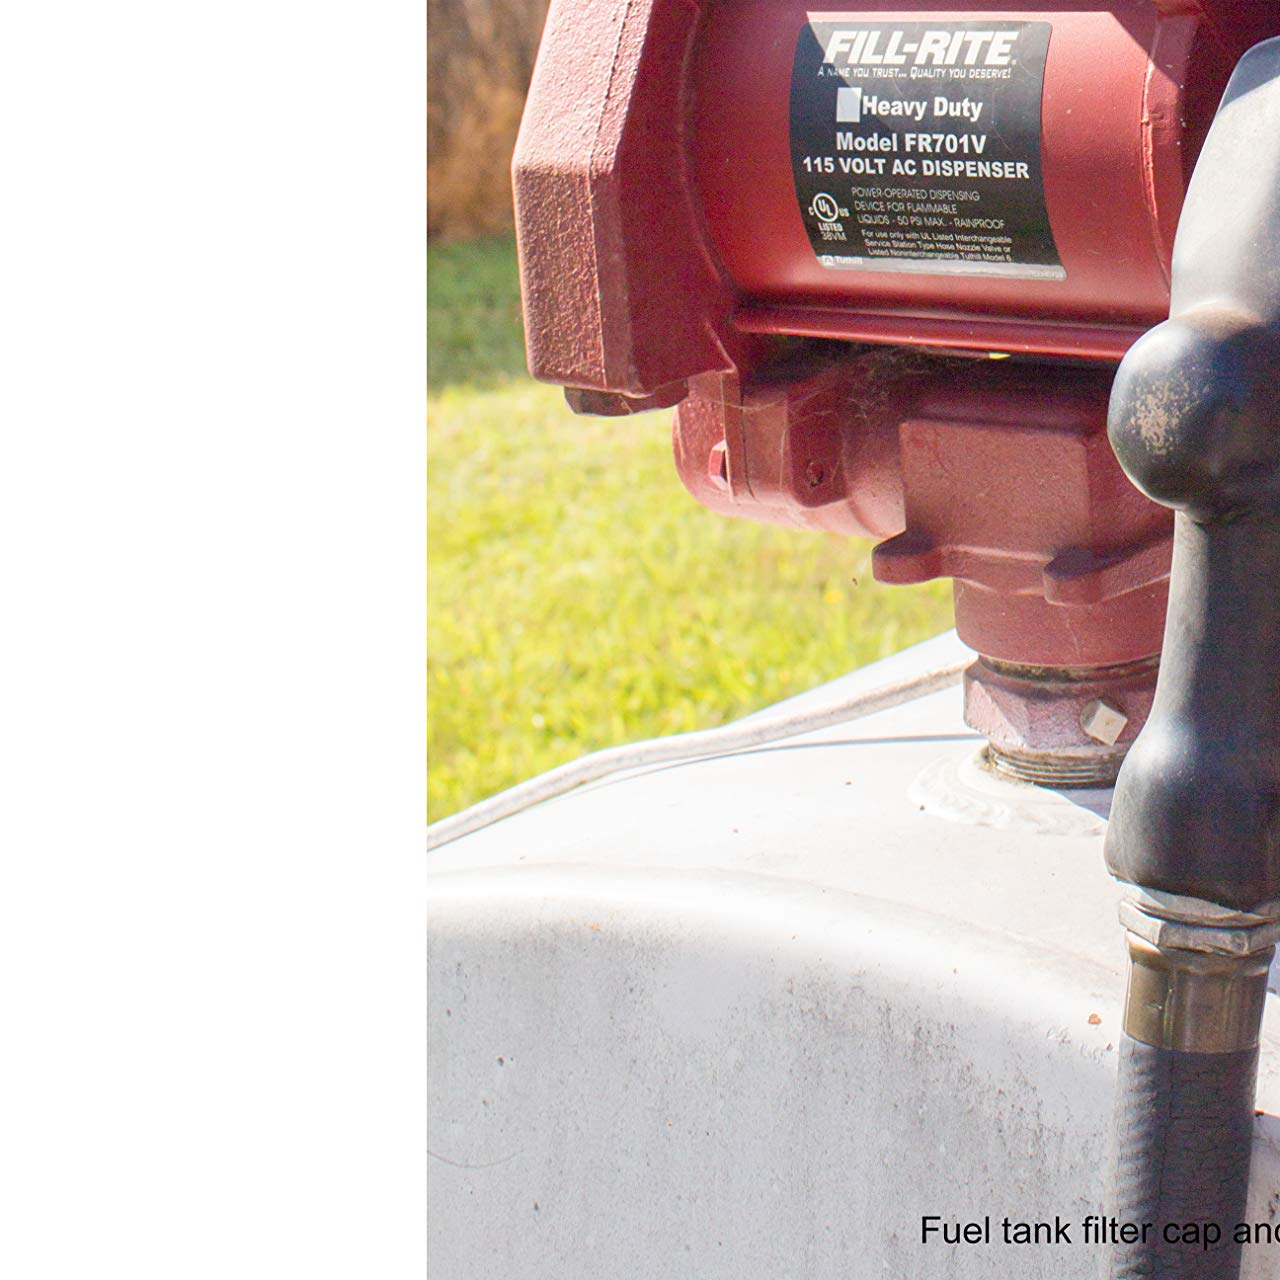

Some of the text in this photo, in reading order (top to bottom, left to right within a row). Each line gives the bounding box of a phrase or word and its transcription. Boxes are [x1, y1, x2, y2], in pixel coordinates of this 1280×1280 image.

[823, 30, 1019, 65] FILL-RITE
[818, 67, 824, 76] A
[852, 67, 870, 78] YOU
[949, 68, 967, 79] YOU
[862, 95, 983, 122] Heavy Duty
[836, 132, 987, 154] Model FR701V
[803, 156, 1029, 179] 115 VOLT AC DISPENSER
[851, 187, 980, 201] POWER-OPERATED DISPENSING
[854, 201, 958, 214] DEVICE FOR FLAMMABLE
[818, 222, 843, 232] LISTED
[857, 214, 890, 225] LIQUIDS
[897, 216, 908, 225] 50
[910, 216, 923, 226] PSI
[954, 218, 1005, 229] RAINPROOF
[861, 229, 873, 238] For
[890, 231, 904, 240] only
[905, 231, 920, 239] with
[920, 232, 932, 240] UL
[932, 232, 954, 241] Listed
[954, 233, 1012, 244] Interchangeable
[865, 238, 890, 247] Service
[891, 240, 917, 249] Station
[916, 241, 935, 251] Type
[935, 242, 955, 251] Hose
[955, 242, 981, 251] Nozzle
[980, 244, 1002, 252] Valve
[868, 248, 889, 257] Listed
